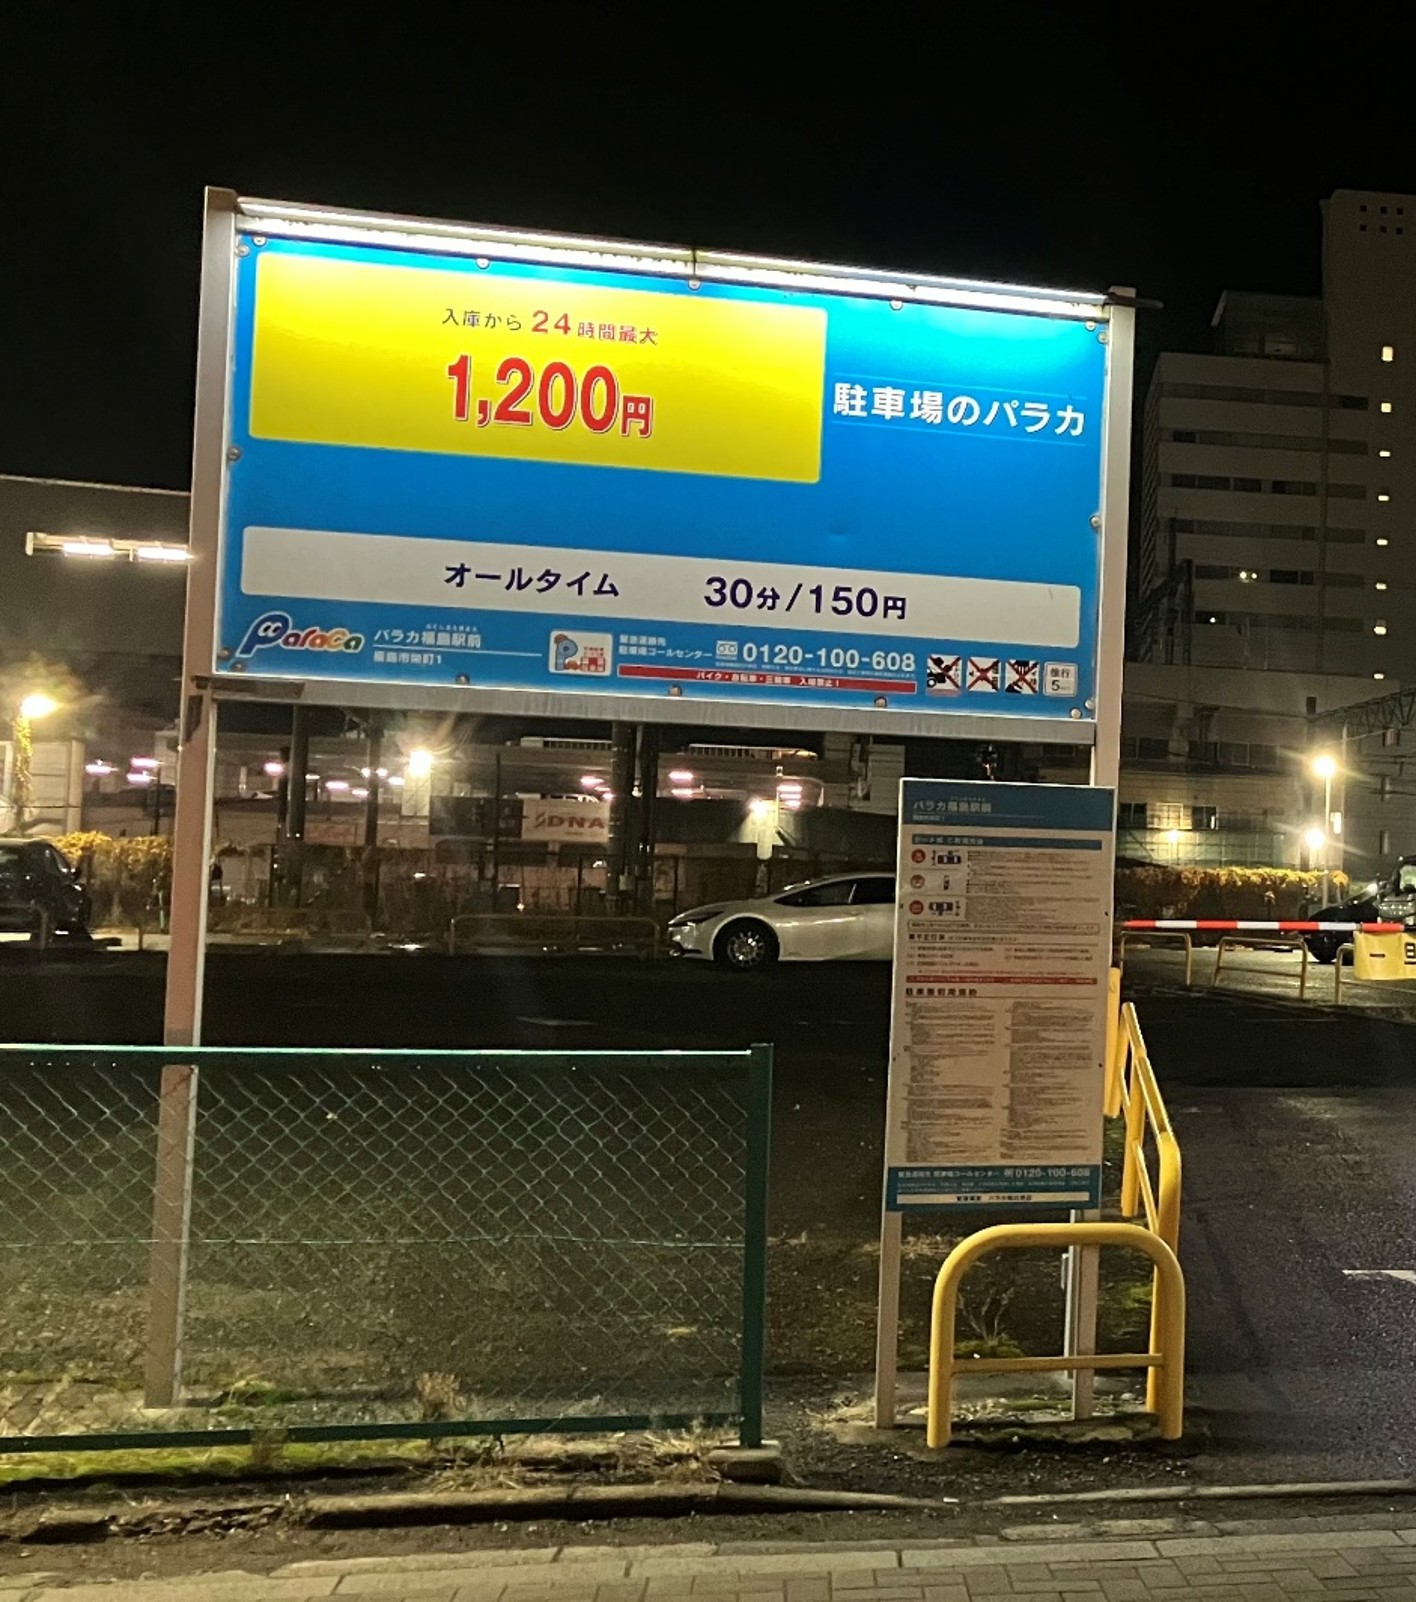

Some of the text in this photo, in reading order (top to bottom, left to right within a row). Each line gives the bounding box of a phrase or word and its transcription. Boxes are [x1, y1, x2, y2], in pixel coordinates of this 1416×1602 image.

[446, 353, 654, 438] 1,200円
[833, 382, 1086, 437] 駐車場のパラカ
[443, 562, 908, 621] オールタイム 30分/150円
[742, 642, 916, 672] 0120-100-608
